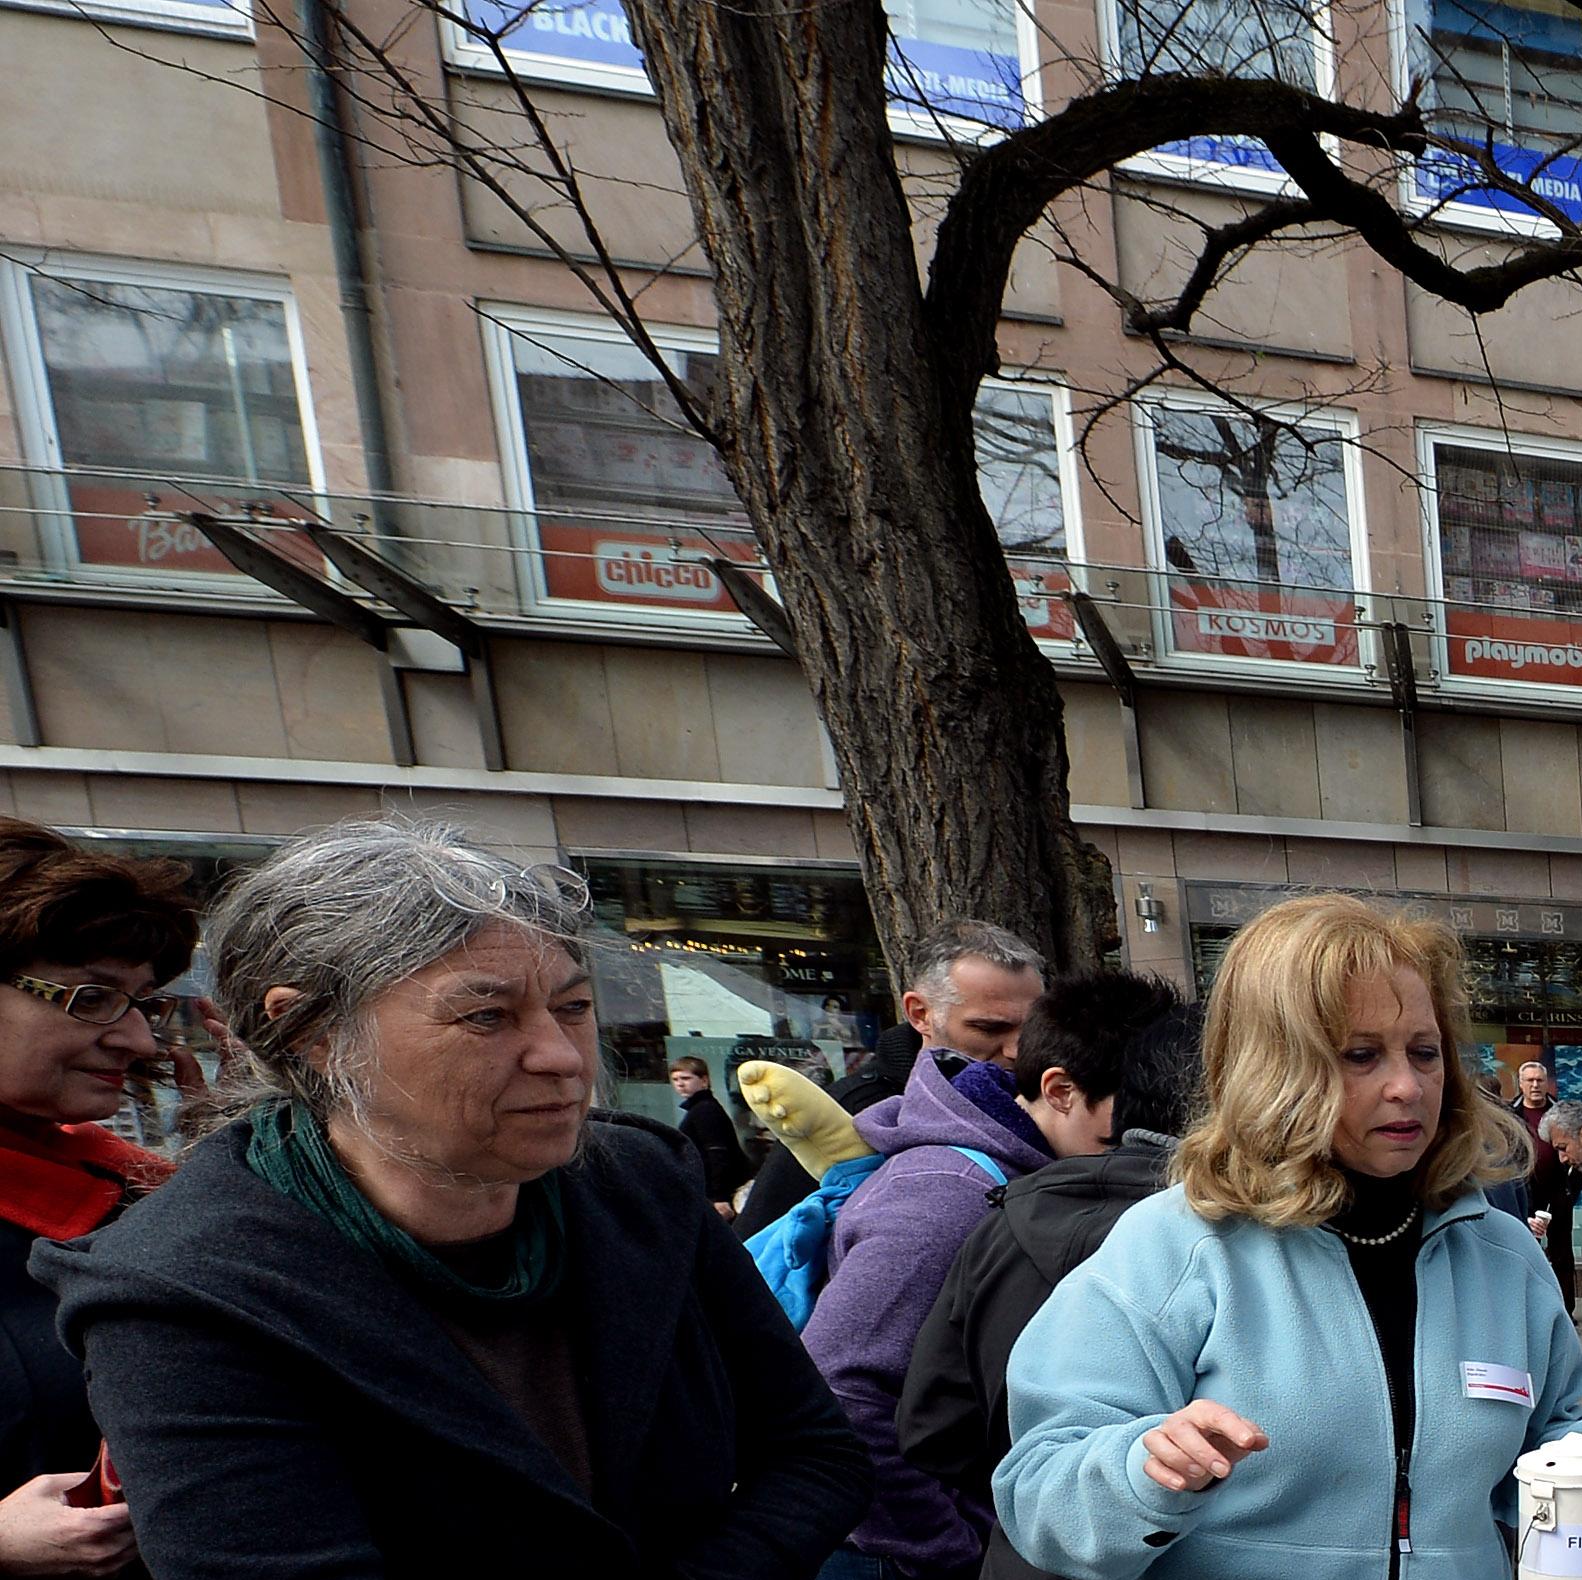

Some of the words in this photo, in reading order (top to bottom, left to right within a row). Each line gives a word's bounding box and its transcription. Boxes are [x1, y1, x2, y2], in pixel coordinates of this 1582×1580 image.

[532, 9, 630, 44] BLACK
[605, 550, 713, 589] chicco
[1208, 612, 1327, 643] KOSMOS
